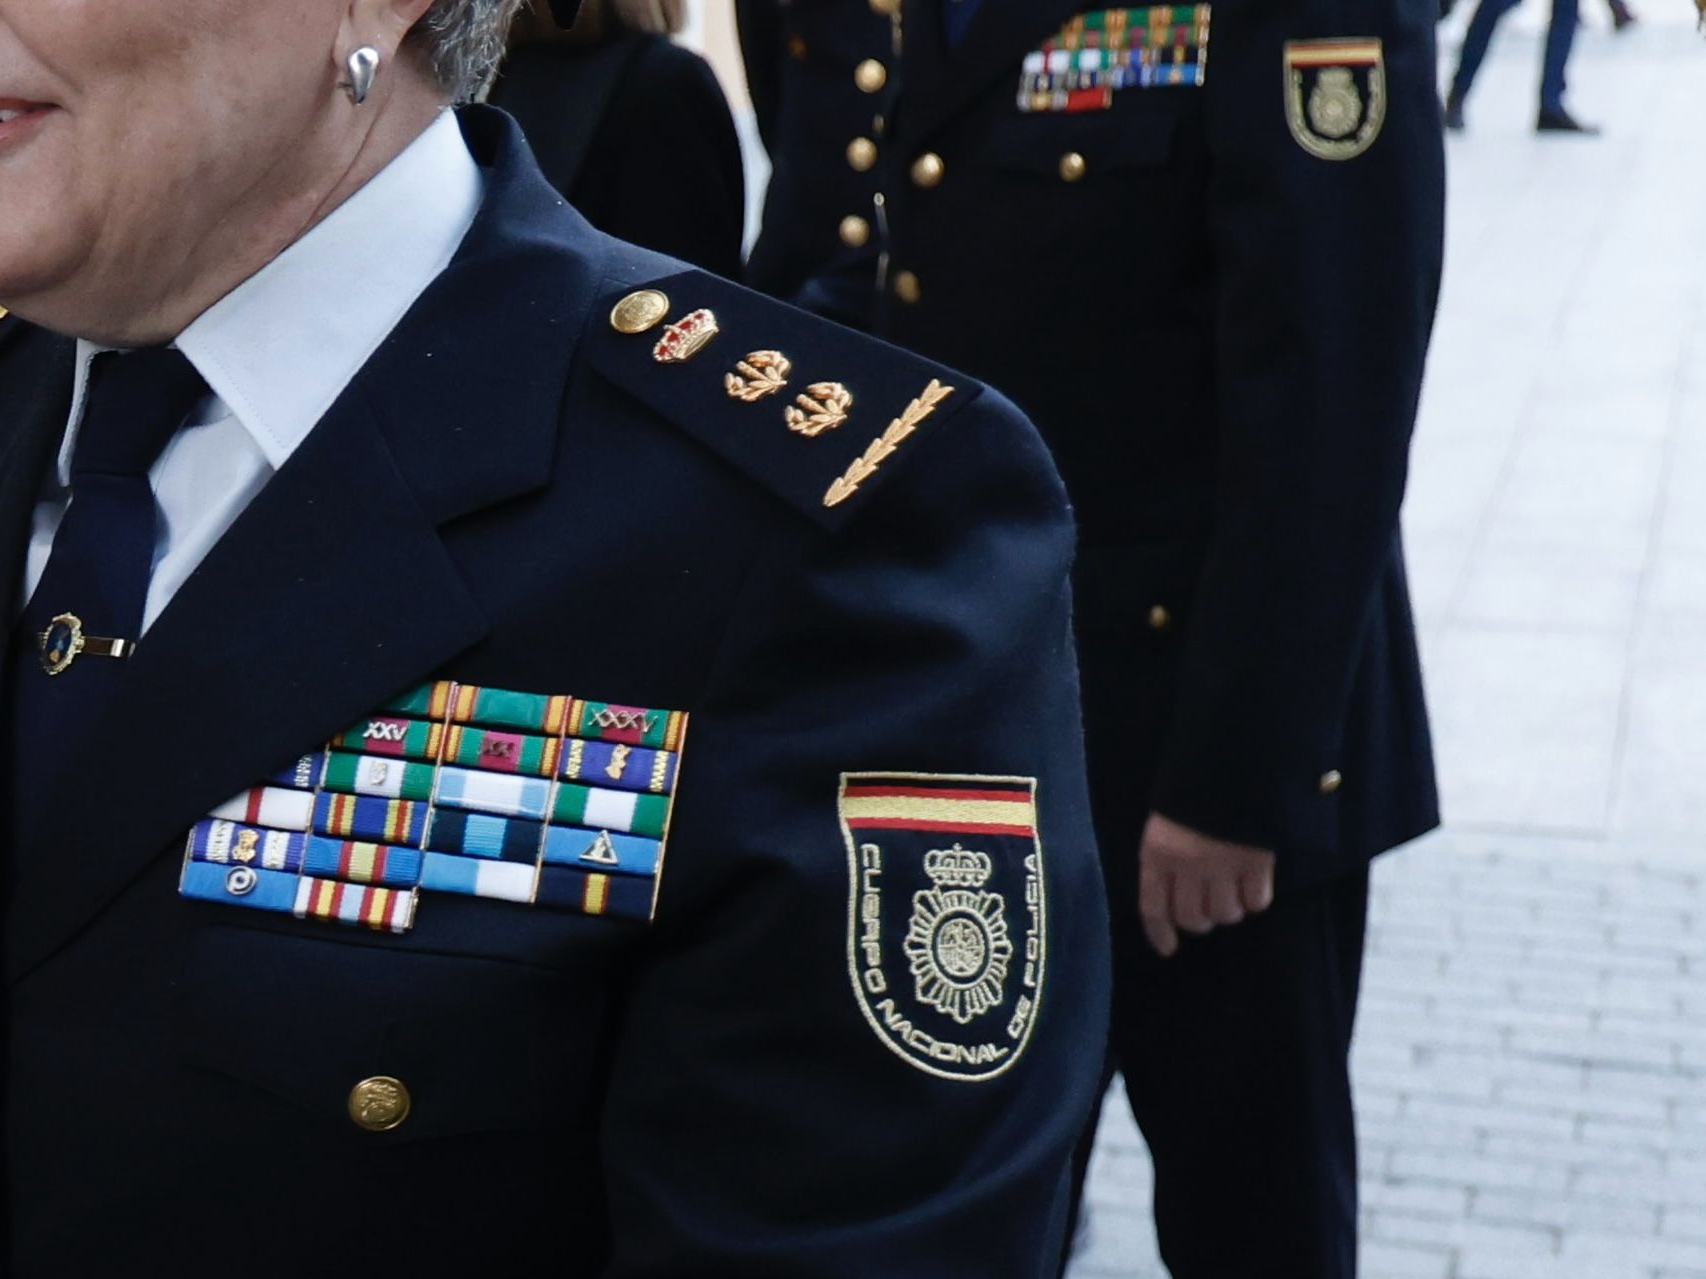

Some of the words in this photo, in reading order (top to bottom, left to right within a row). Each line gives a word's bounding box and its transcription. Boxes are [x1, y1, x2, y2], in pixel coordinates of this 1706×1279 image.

[363, 721, 407, 740] XXV
[588, 708, 658, 732] XXXV
[861, 844, 886, 993] CUERPO
[876, 999, 1009, 1064] NACIONAL
[1006, 994, 1032, 1039] DE
